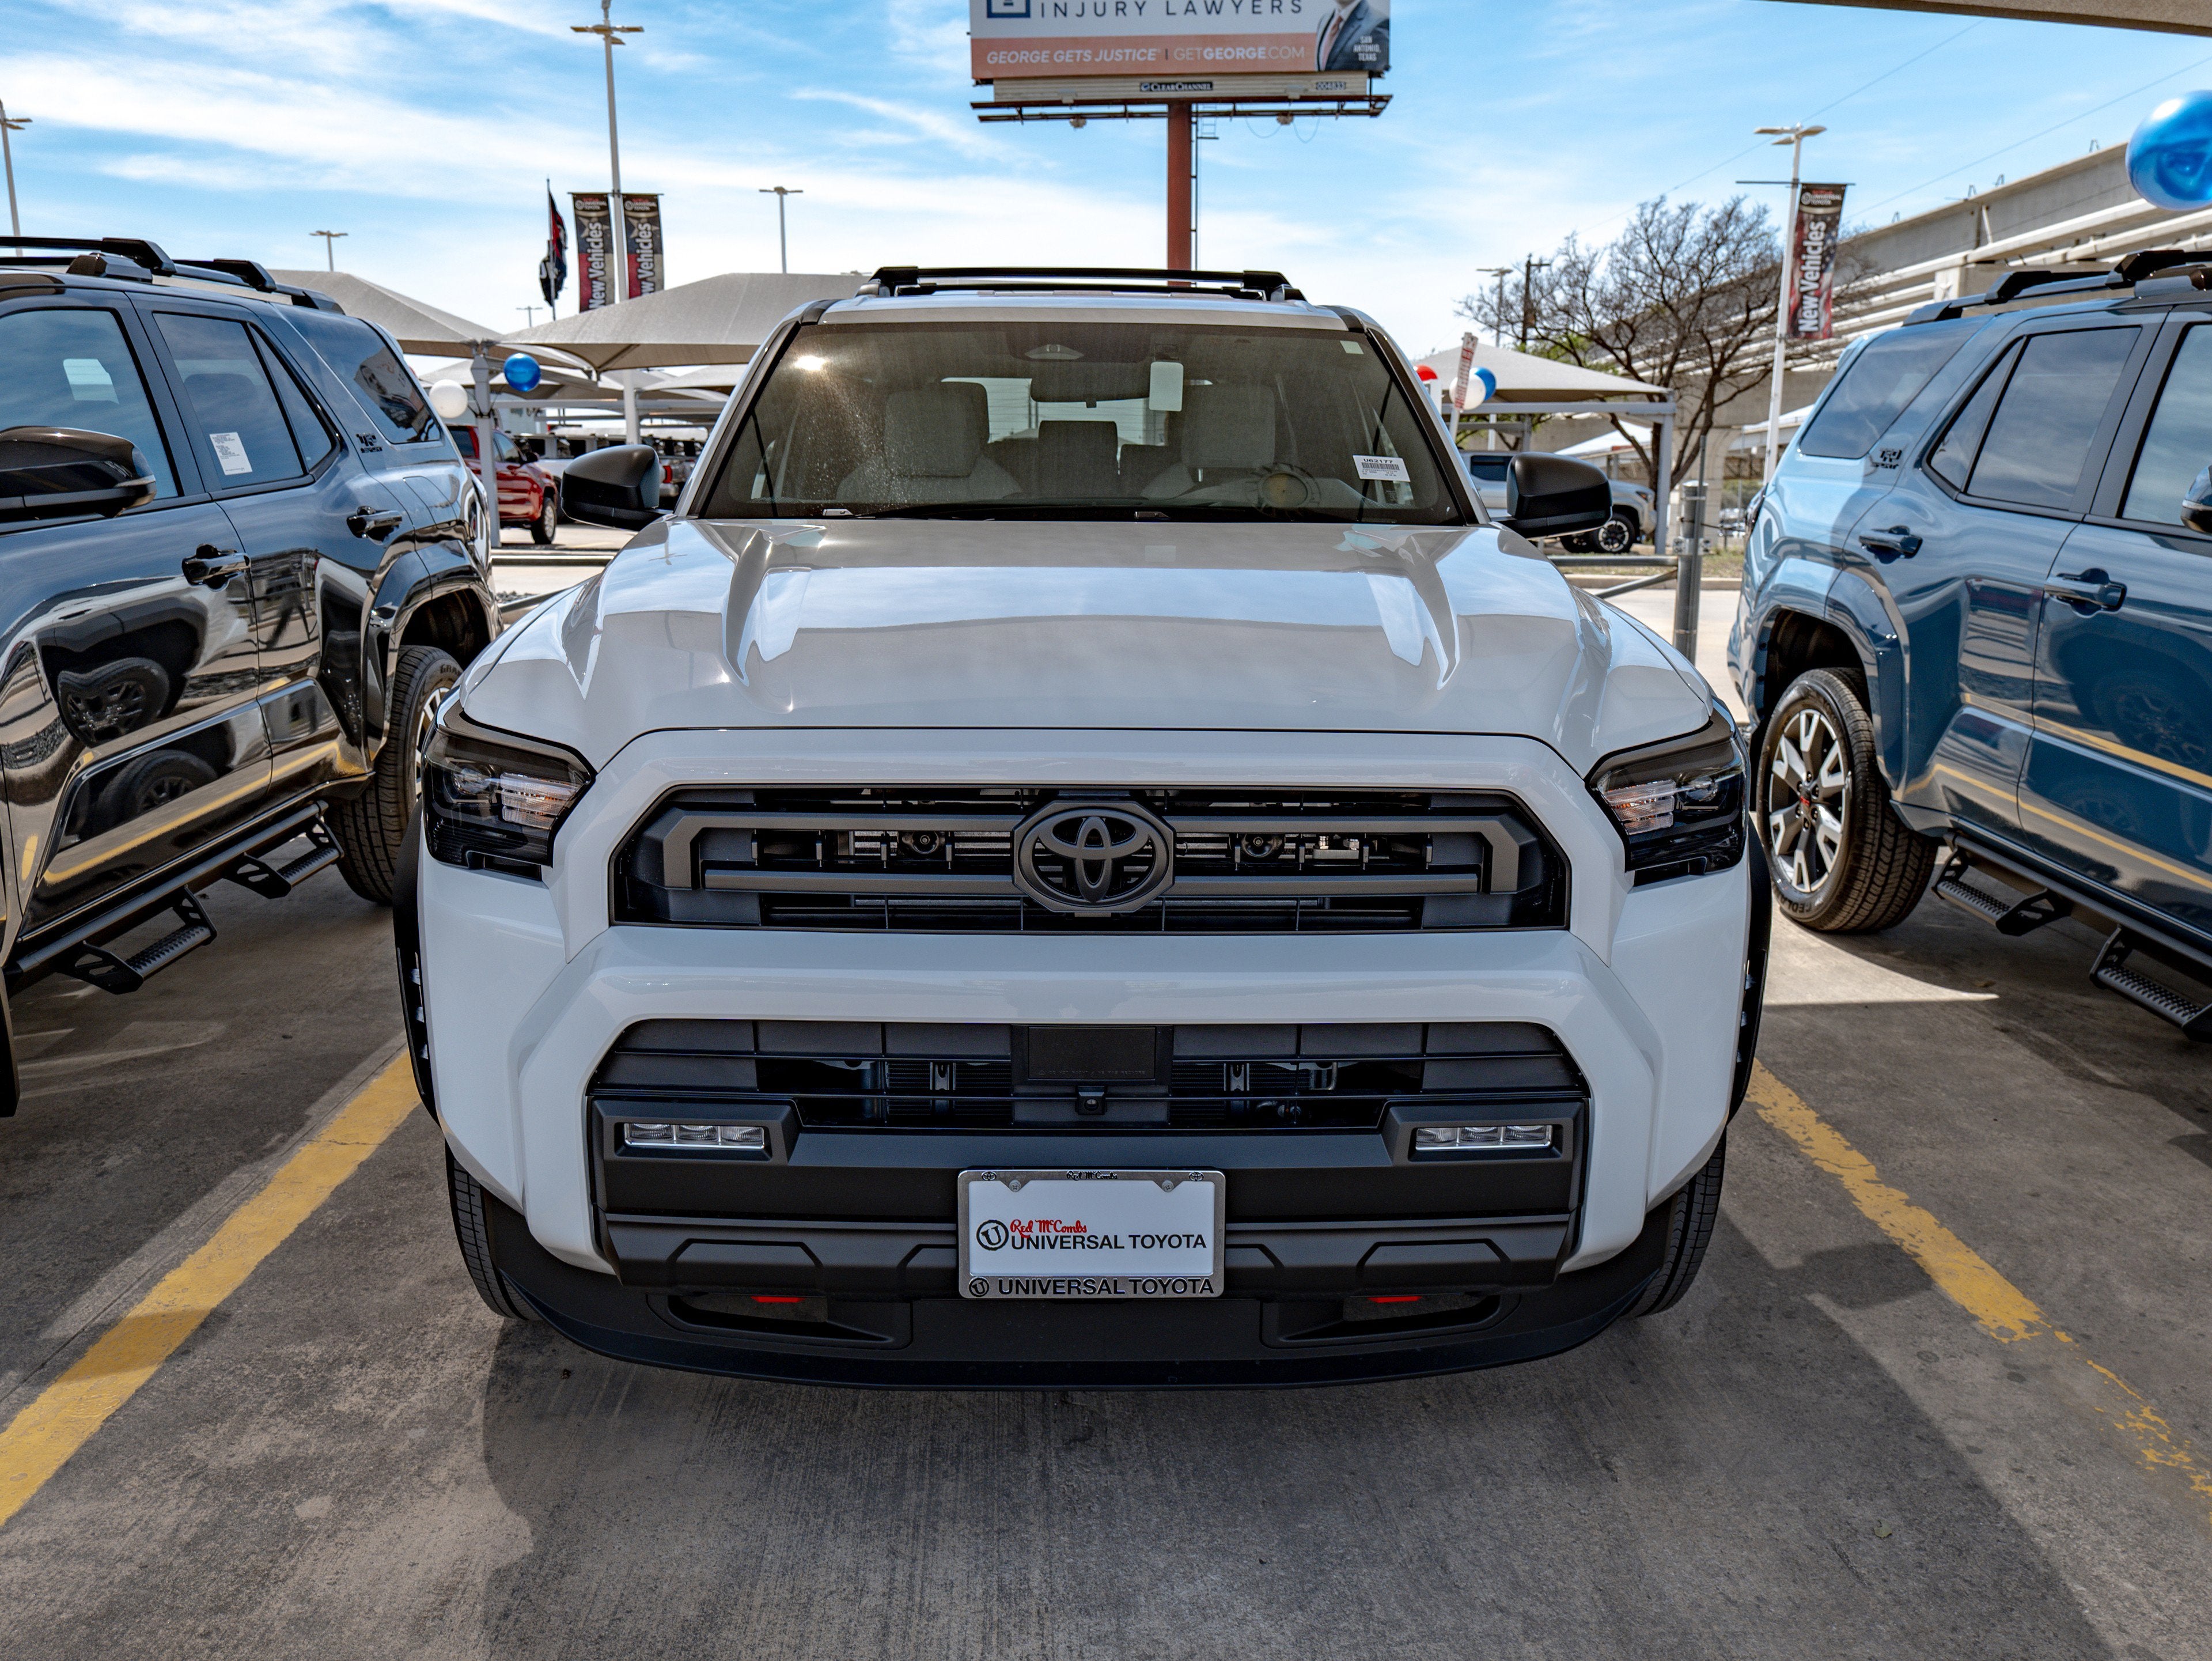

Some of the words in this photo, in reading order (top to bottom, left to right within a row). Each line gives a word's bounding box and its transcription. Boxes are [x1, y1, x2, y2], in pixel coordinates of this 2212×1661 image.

[1041, 1, 1146, 18] INJURY
[1166, 0, 1302, 15] LAWYERS
[987, 50, 1050, 65] GEORGE
[1053, 50, 1092, 63] GETS
[1173, 46, 1305, 61] GETGEORGE.COM
[586, 222, 605, 278] Vehicles
[635, 223, 654, 279] Vehicles
[1800, 221, 1827, 293] Vehicles
[1798, 295, 1819, 332] New
[1066, 1171, 1082, 1181] Red
[1084, 1171, 1118, 1180] McCombs
[1010, 1219, 1033, 1238] Red
[1035, 1219, 1087, 1234] McCombs
[1012, 1235, 1124, 1250] UNIVERSAL
[1128, 1234, 1206, 1249] TOYOTA
[998, 1277, 1126, 1295] UNIVERSAL
[1129, 1277, 1215, 1295] TOYOTA
